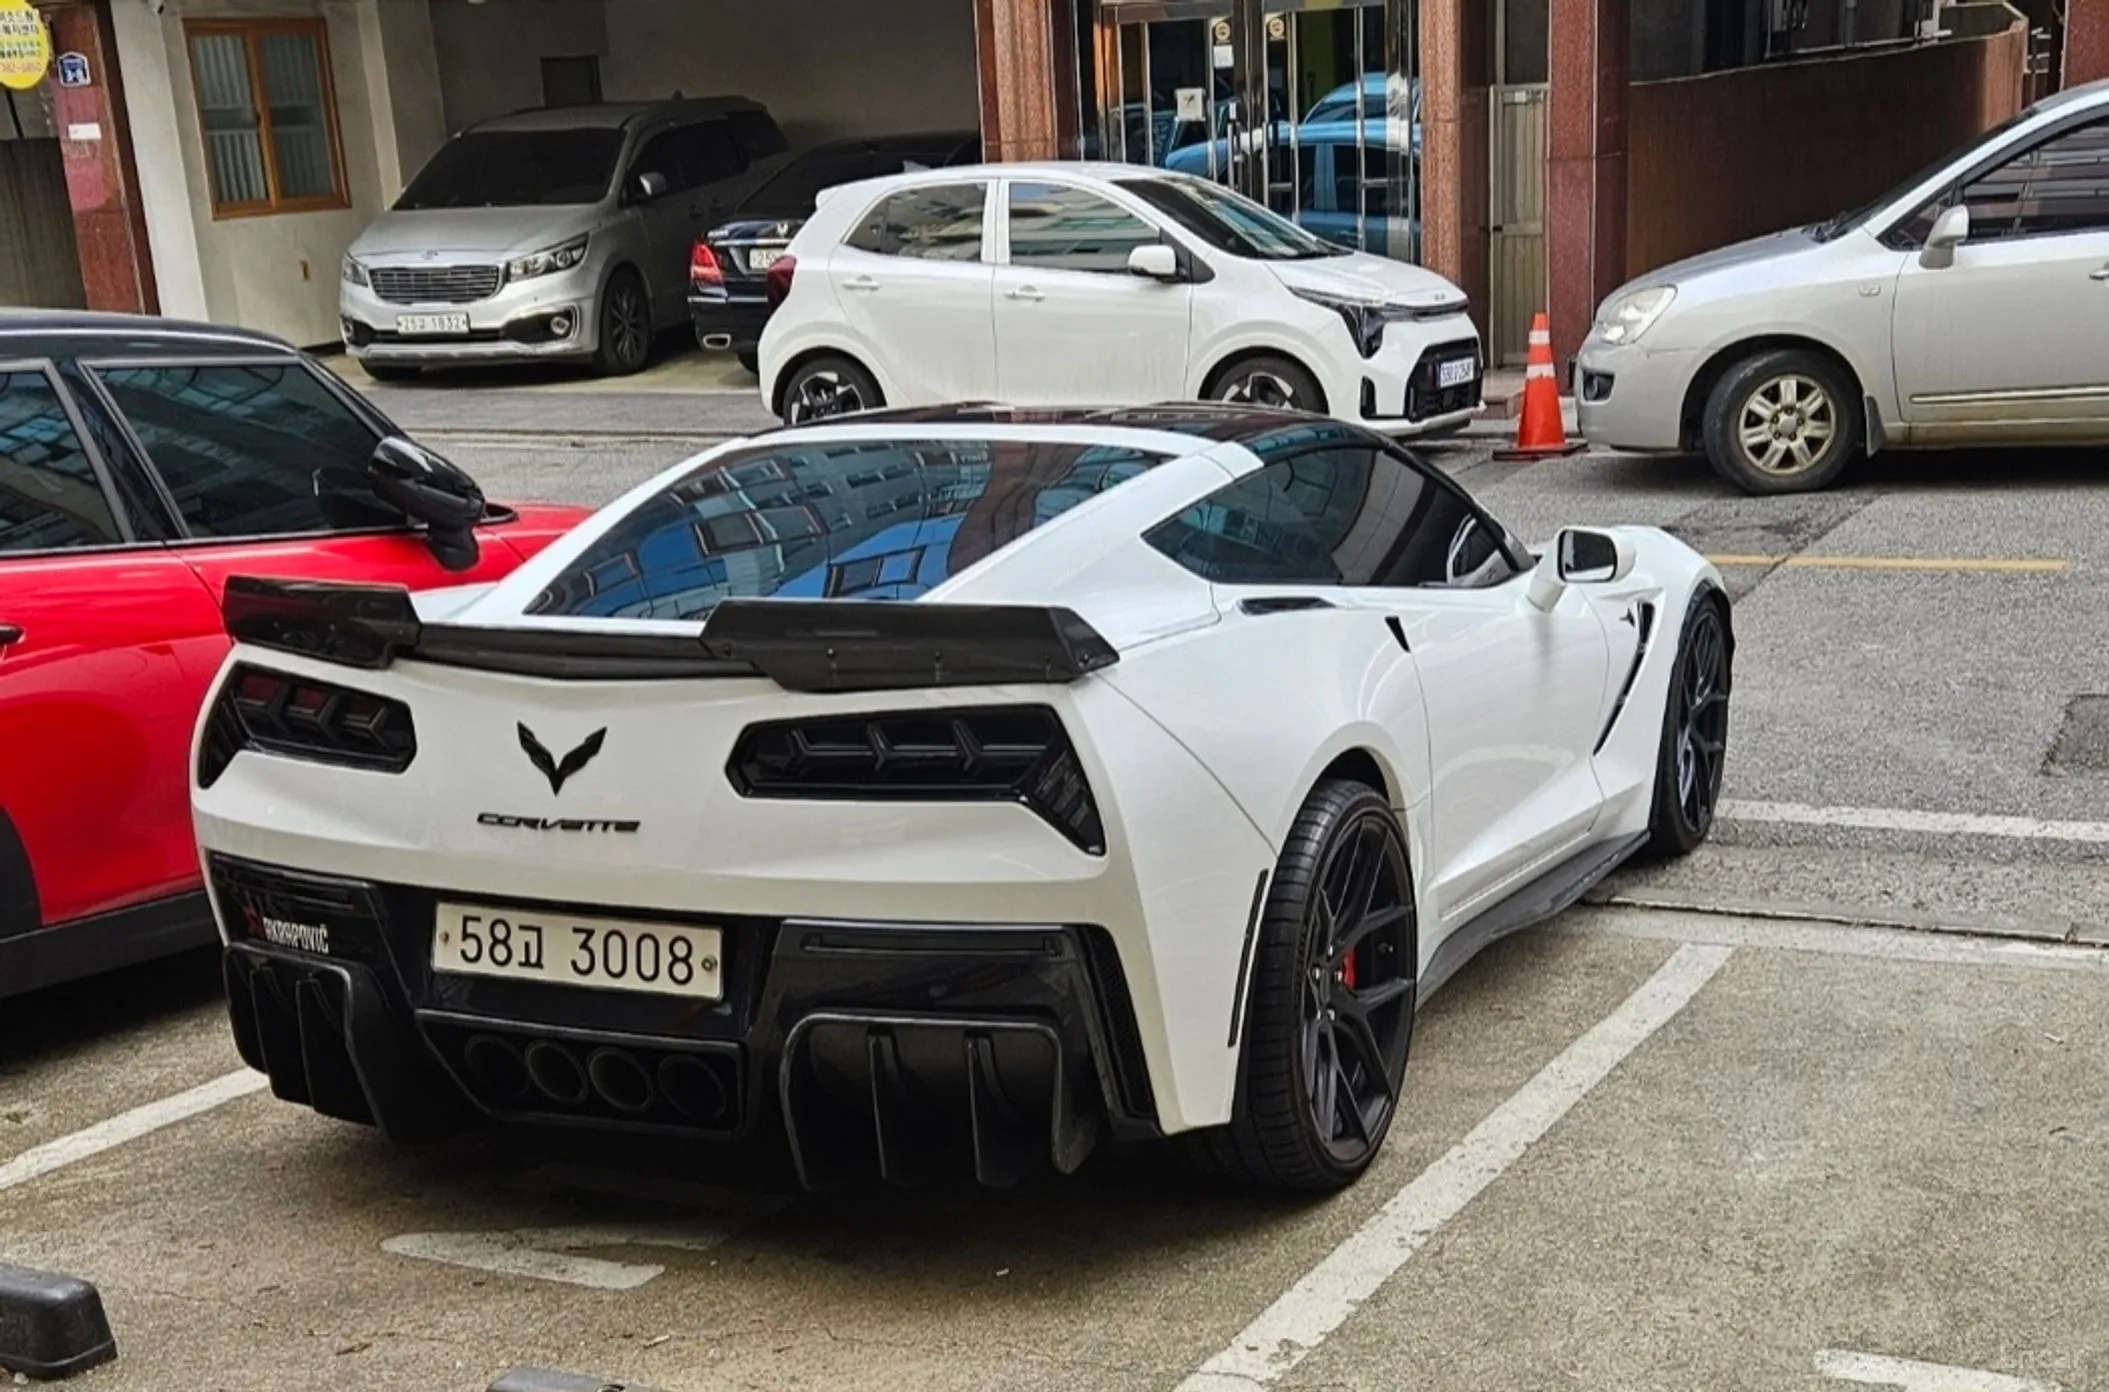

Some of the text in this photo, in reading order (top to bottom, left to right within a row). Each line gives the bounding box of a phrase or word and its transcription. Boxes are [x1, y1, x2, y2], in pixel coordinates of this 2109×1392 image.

[477, 812, 641, 832] CORVETTE
[460, 915, 694, 986] 58고 3008
